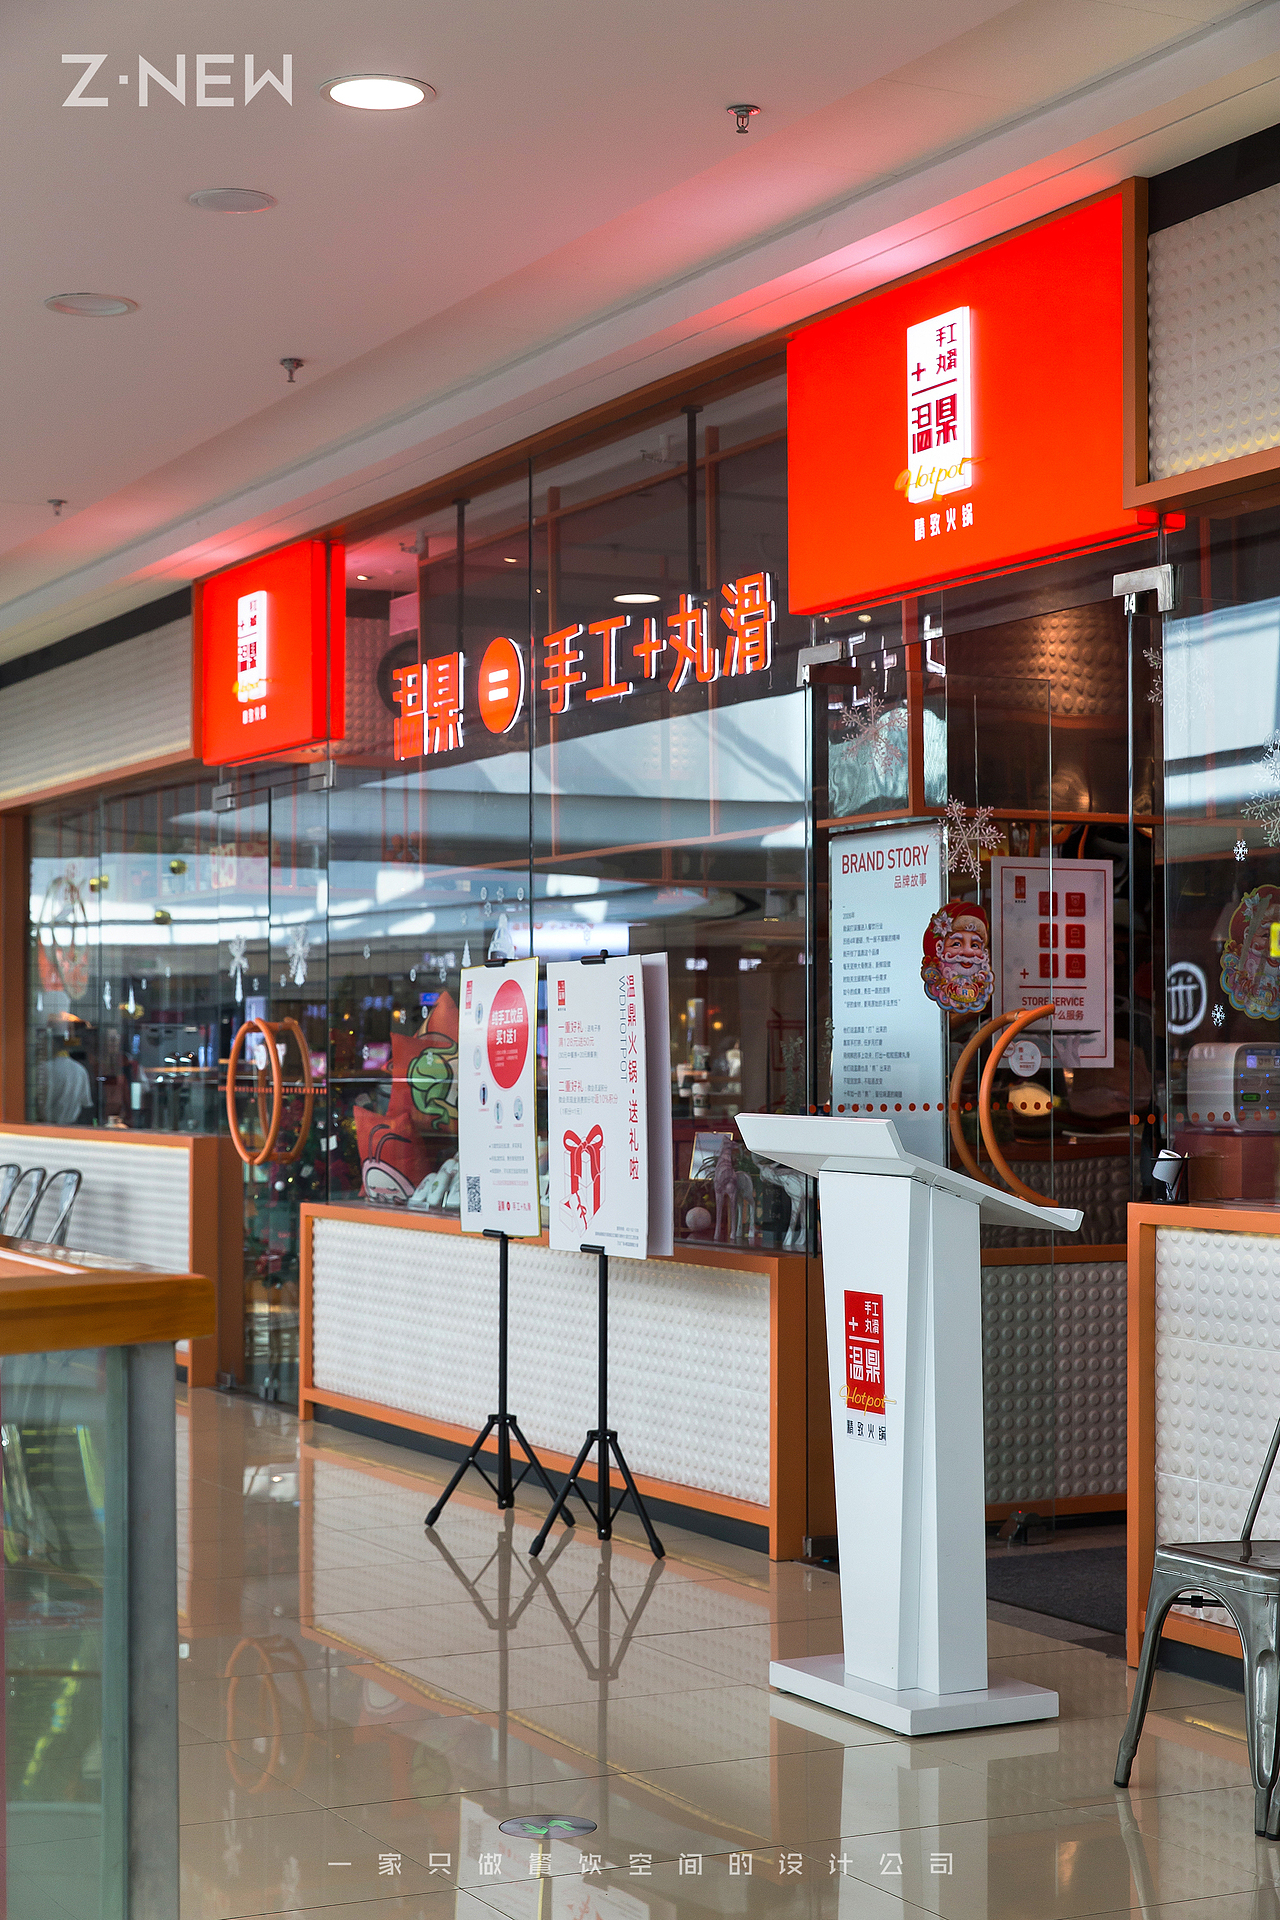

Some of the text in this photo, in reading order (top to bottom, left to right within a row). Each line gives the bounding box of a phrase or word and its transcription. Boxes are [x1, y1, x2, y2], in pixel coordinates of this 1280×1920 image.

[936, 322, 957, 347] 手工
[912, 393, 957, 455] 温鼎
[894, 457, 986, 502] Hotpot
[914, 503, 974, 541] 精致火锅
[841, 844, 930, 875] BRAND STORY
[894, 872, 928, 889] 品牌故事
[1021, 996, 1049, 1007] STORE
[495, 1028, 517, 1046] 买1送1
[864, 1300, 879, 1317] 手工
[864, 1318, 880, 1335] 丸滑
[848, 1345, 881, 1384] 温鼎
[838, 1384, 897, 1417] Hotpot
[846, 1419, 887, 1442] 精致火锅
